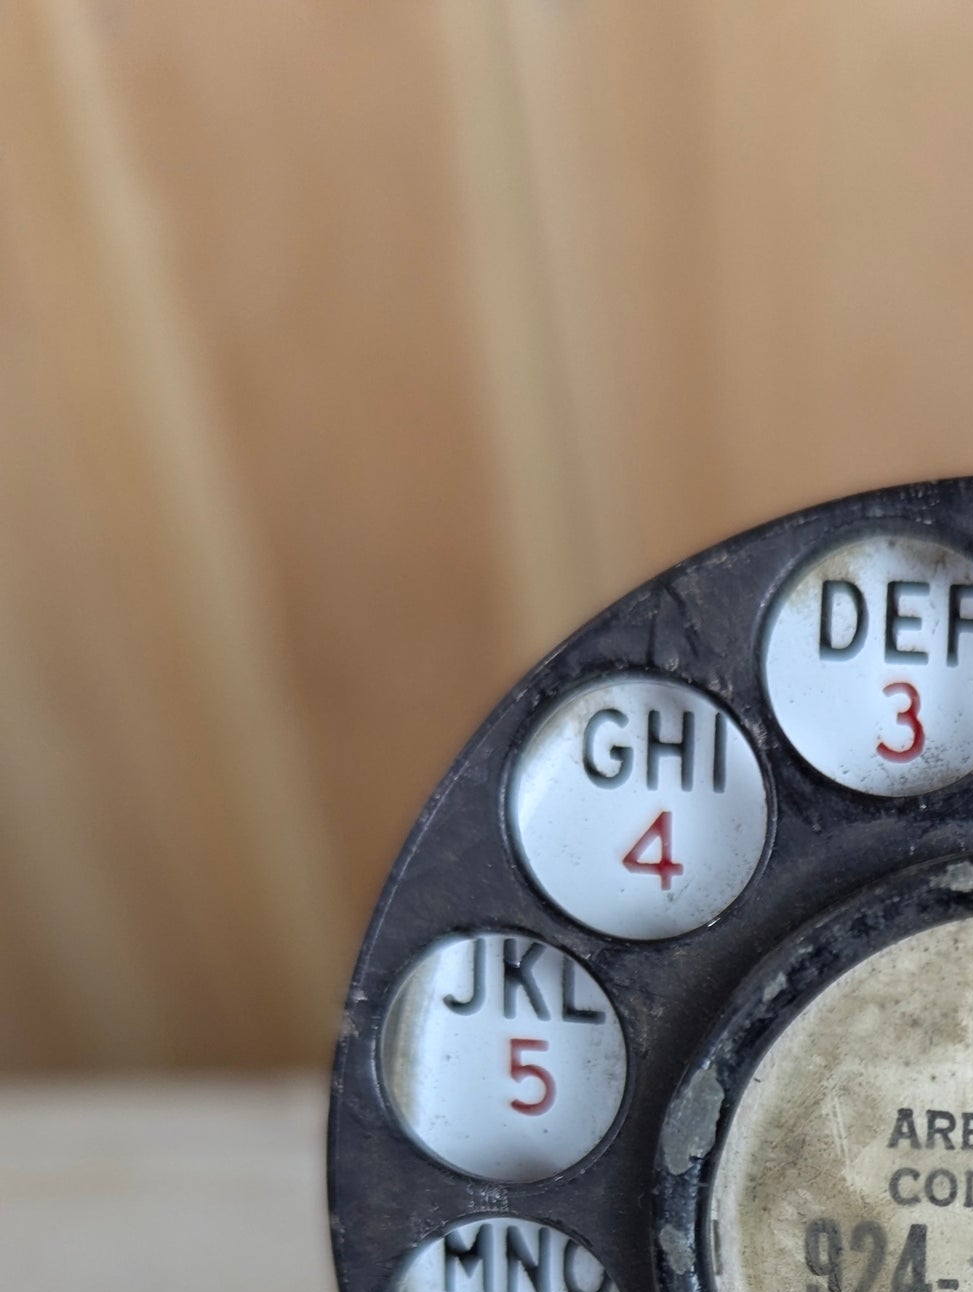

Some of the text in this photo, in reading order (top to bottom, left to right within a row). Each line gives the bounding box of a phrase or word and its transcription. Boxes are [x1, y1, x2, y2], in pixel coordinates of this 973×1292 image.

[582, 706, 727, 794] GHI
[876, 681, 926, 764] 3
[622, 810, 685, 891] 4
[442, 937, 606, 1025] JKL
[510, 1038, 557, 1117] 5
